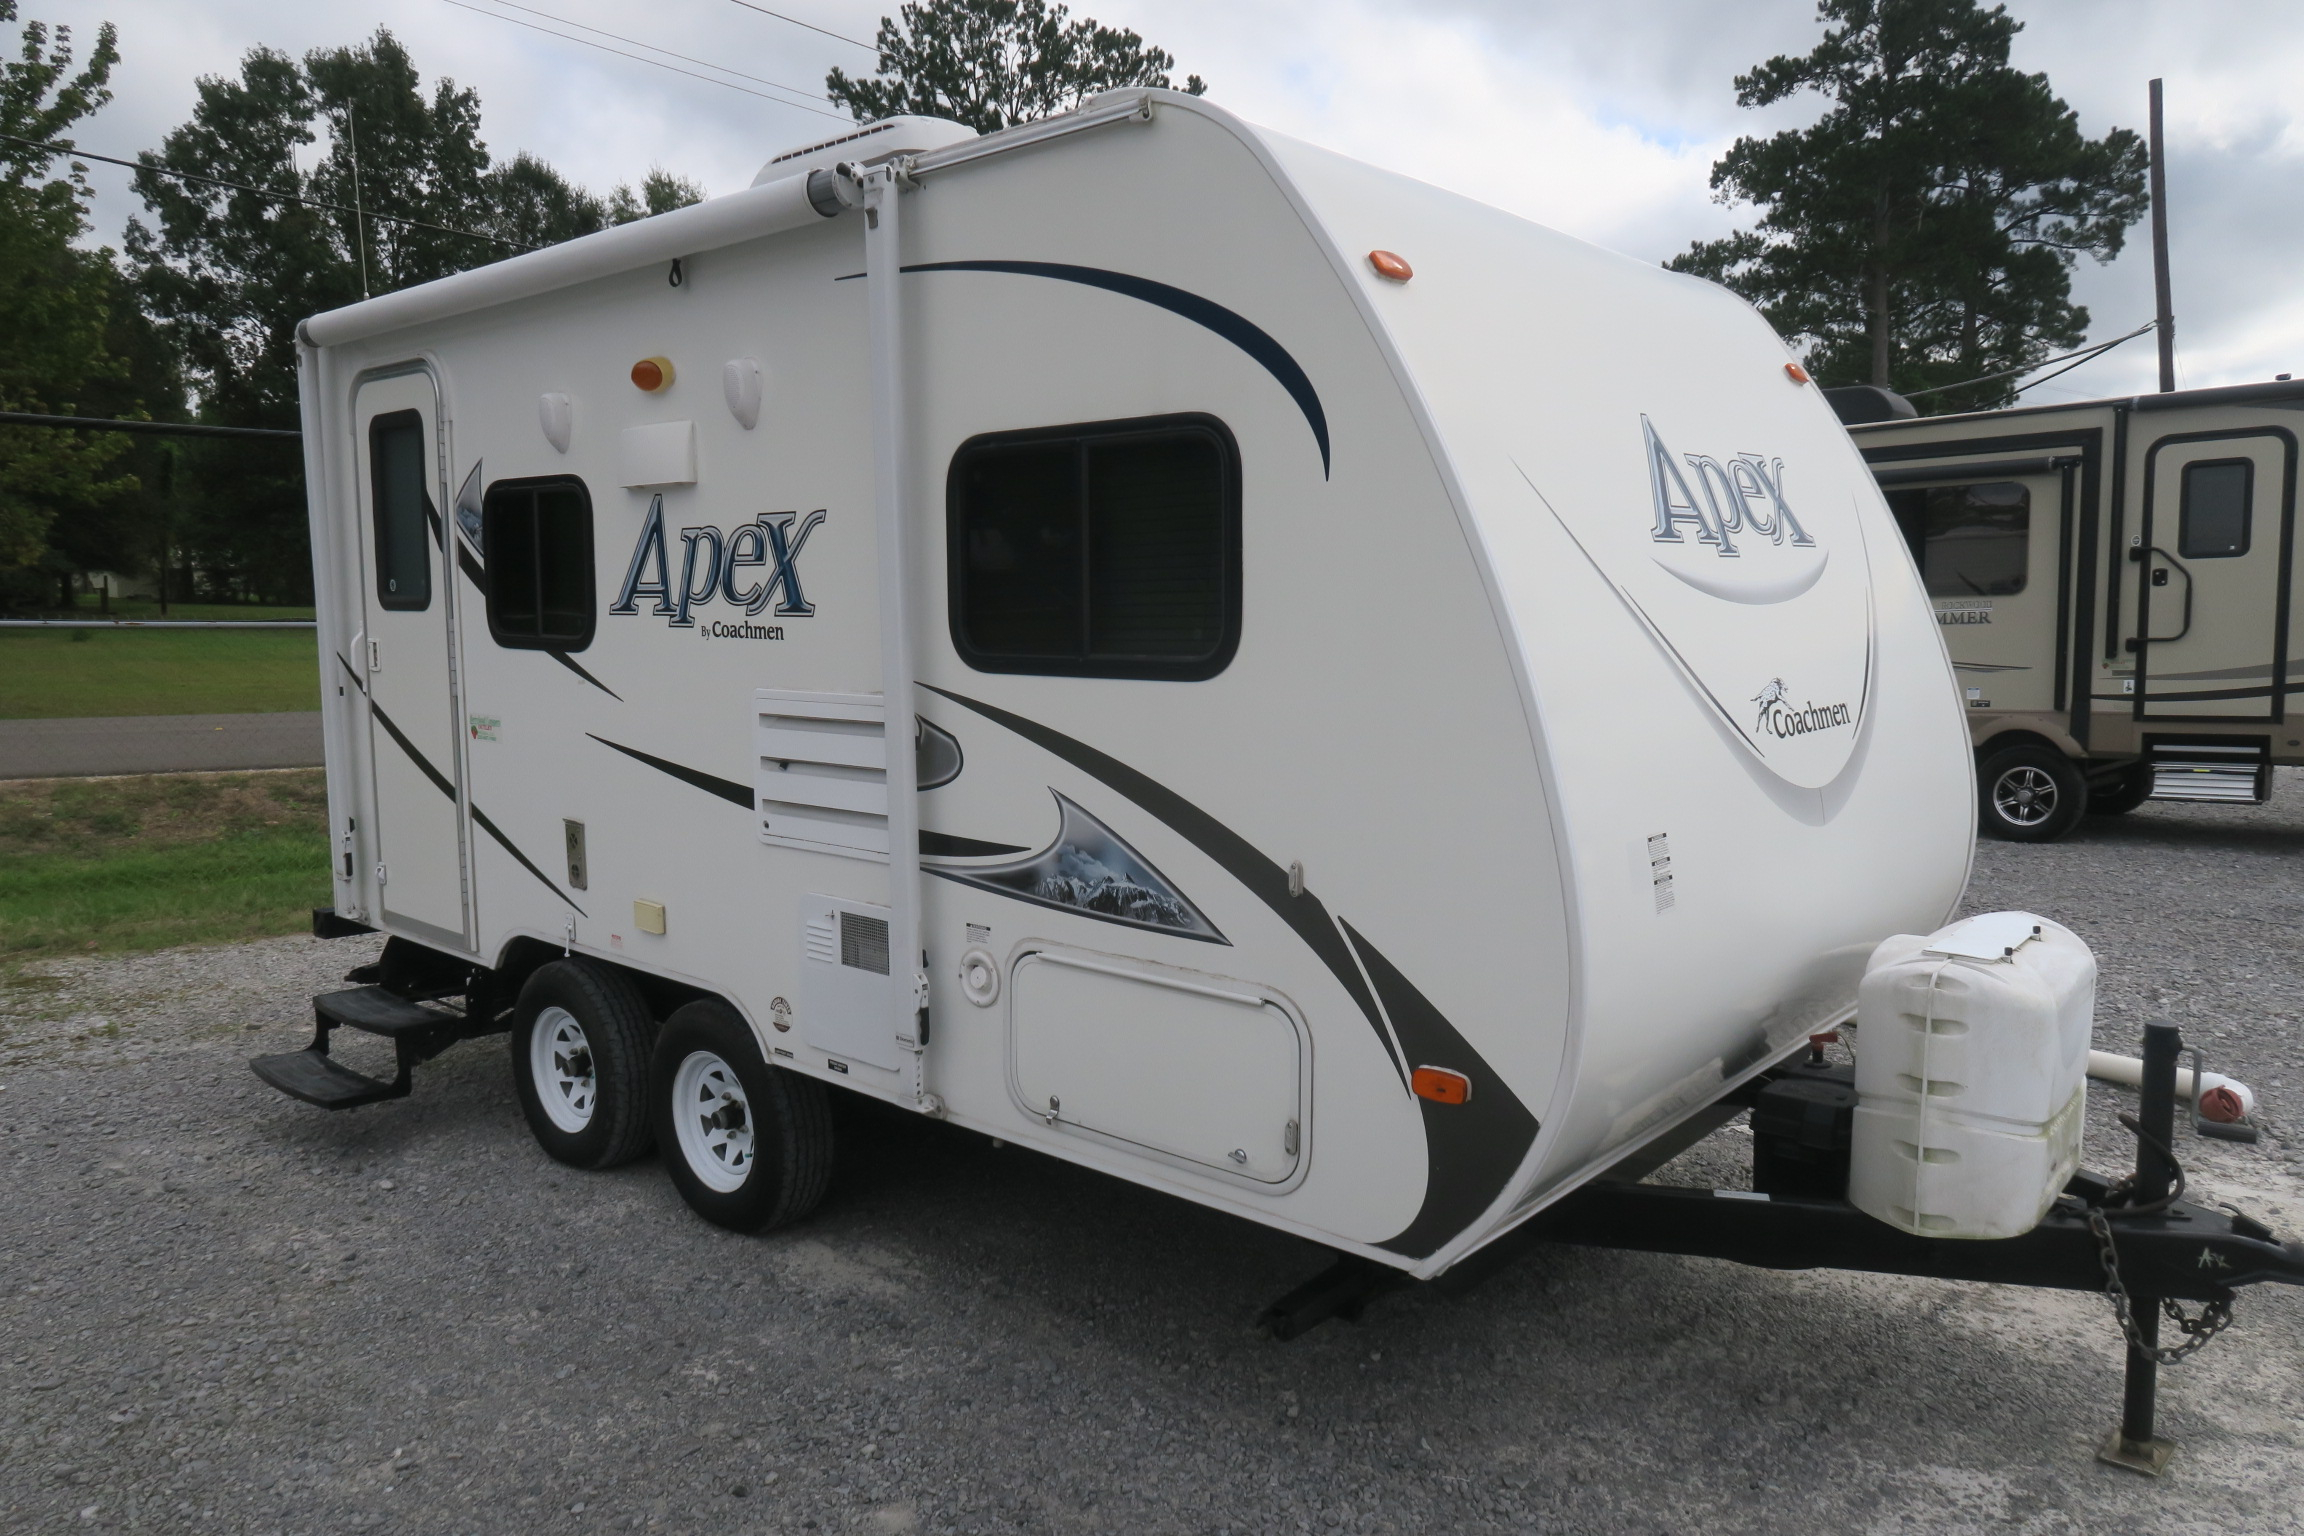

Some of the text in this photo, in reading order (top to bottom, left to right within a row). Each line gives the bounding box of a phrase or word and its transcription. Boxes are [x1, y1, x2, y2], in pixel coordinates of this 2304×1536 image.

[701, 620, 785, 640] By Coachmen
[1773, 700, 1851, 739] Coachmen
